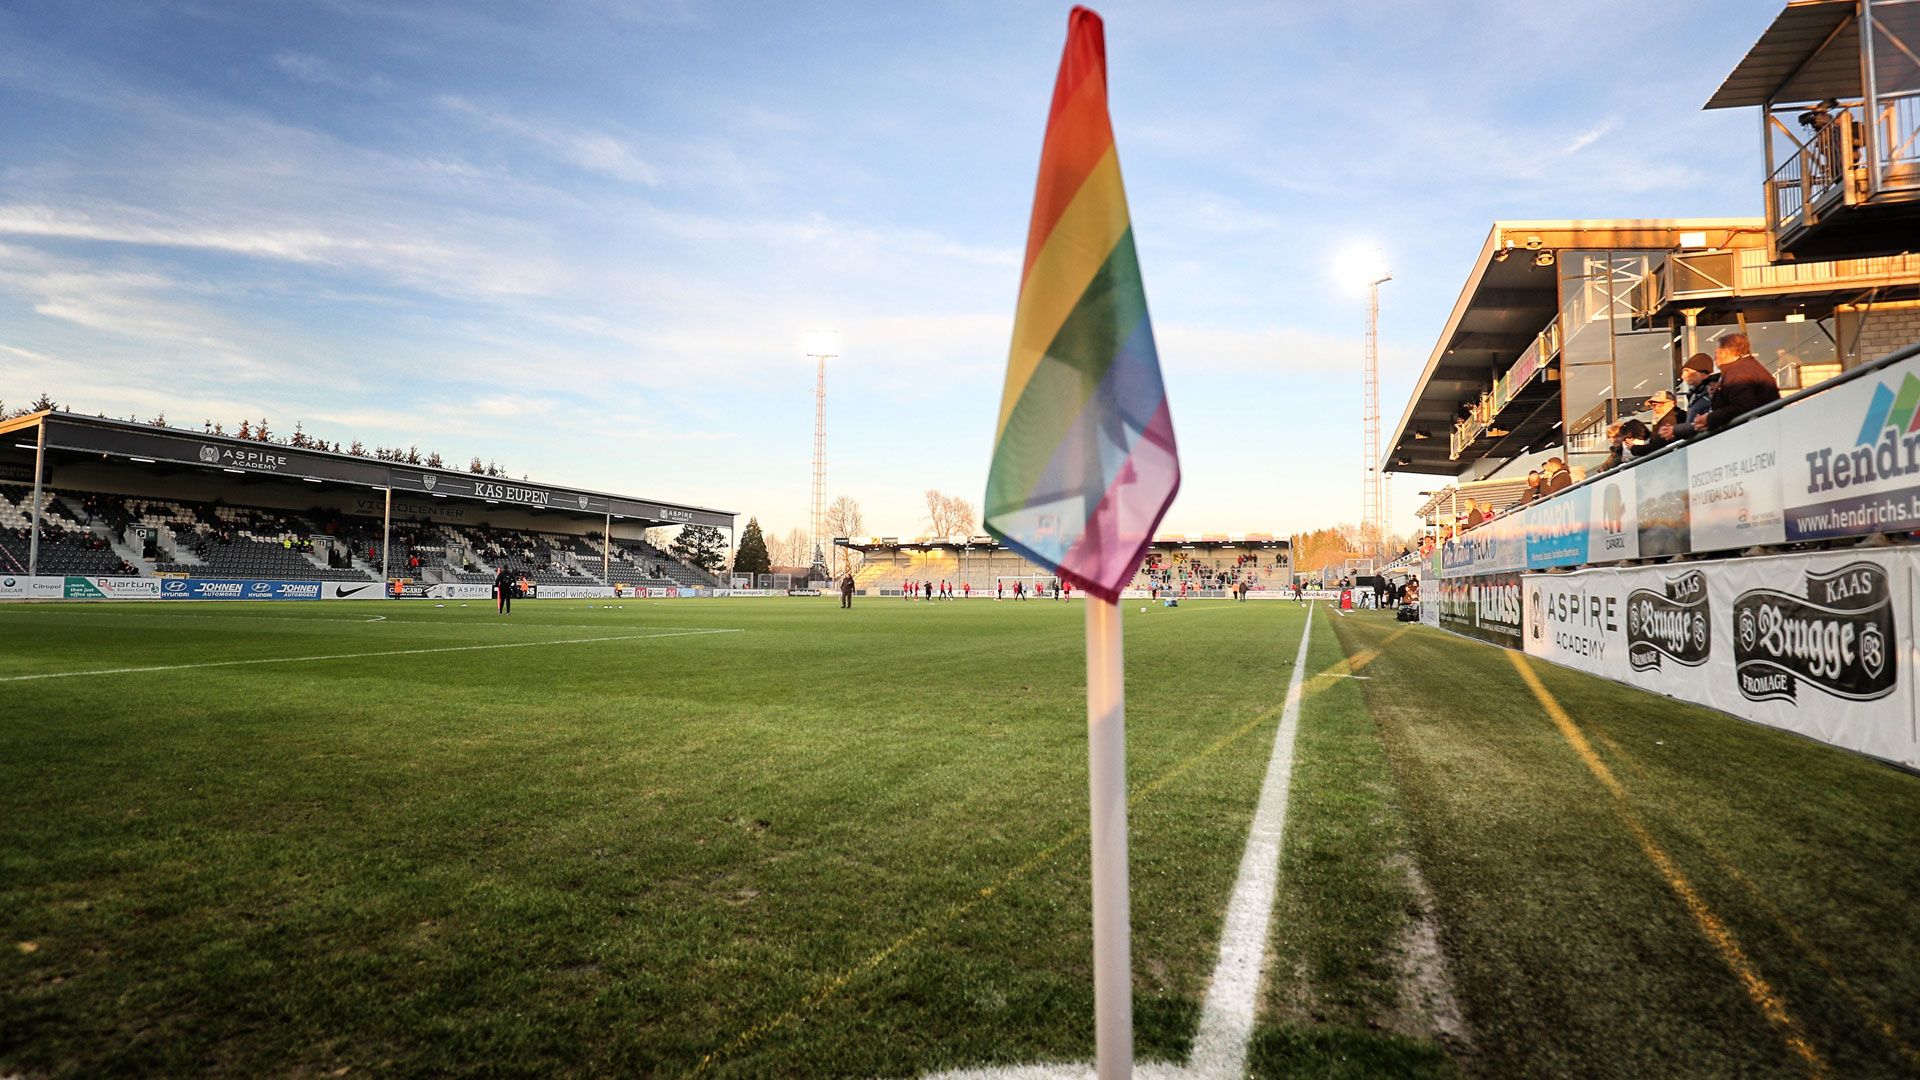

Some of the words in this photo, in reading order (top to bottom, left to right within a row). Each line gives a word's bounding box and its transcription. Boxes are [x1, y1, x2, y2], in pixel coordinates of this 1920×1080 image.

[223, 449, 287, 465] ASPIRE
[232, 460, 277, 470] ACADEMY
[1692, 467, 1723, 488] DISCOVER
[1724, 462, 1739, 478] THE
[474, 482, 503, 498] KAS
[505, 487, 550, 504] EUPEN
[669, 510, 693, 519] ASPIRE
[97, 578, 155, 589] Quartum
[195, 583, 244, 592] JOHNEN
[278, 584, 319, 593] JOHNEN
[537, 588, 568, 598] minimal
[570, 588, 602, 598] windows
[1675, 577, 1700, 599] KAAS
[1826, 572, 1872, 603] KAAS
[1548, 589, 1618, 637] ASPIRE
[1640, 600, 1691, 653] Brugge
[1556, 631, 1606, 661] ACADEMY
[1758, 604, 1855, 679] Brugge
[1631, 651, 1658, 665] FROMAGE
[1742, 674, 1788, 693] FROMAGE
